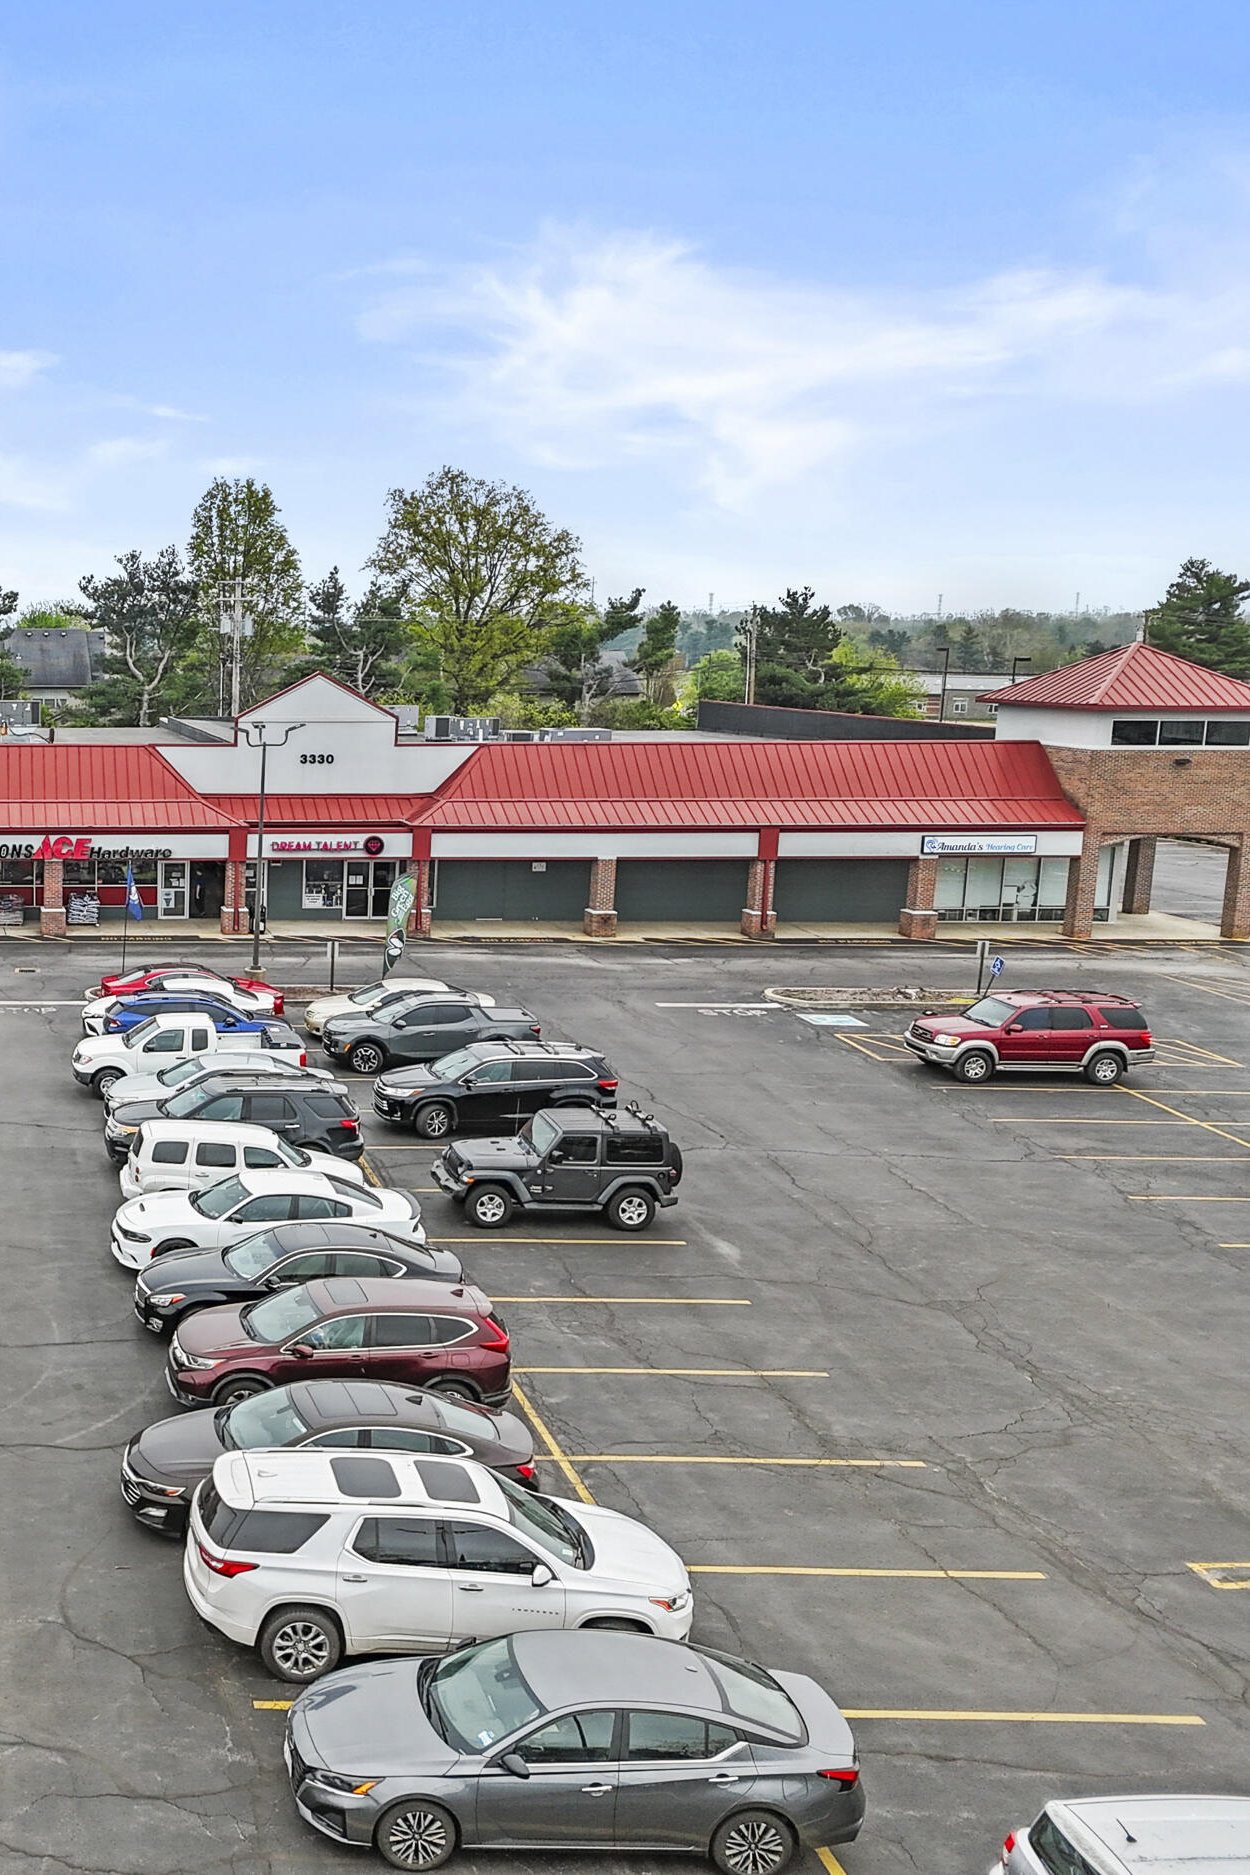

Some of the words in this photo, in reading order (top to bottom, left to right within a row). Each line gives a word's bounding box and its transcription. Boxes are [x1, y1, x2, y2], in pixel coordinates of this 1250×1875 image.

[300, 753, 334, 764] 3330
[31, 834, 92, 860] ACE
[90, 846, 172, 859] Hardware
[271, 841, 312, 851] DREAM
[315, 841, 360, 851] TALENT
[938, 841, 983, 851] Amanda's
[986, 843, 1016, 852] Hearing
[391, 883, 406, 901] Big
